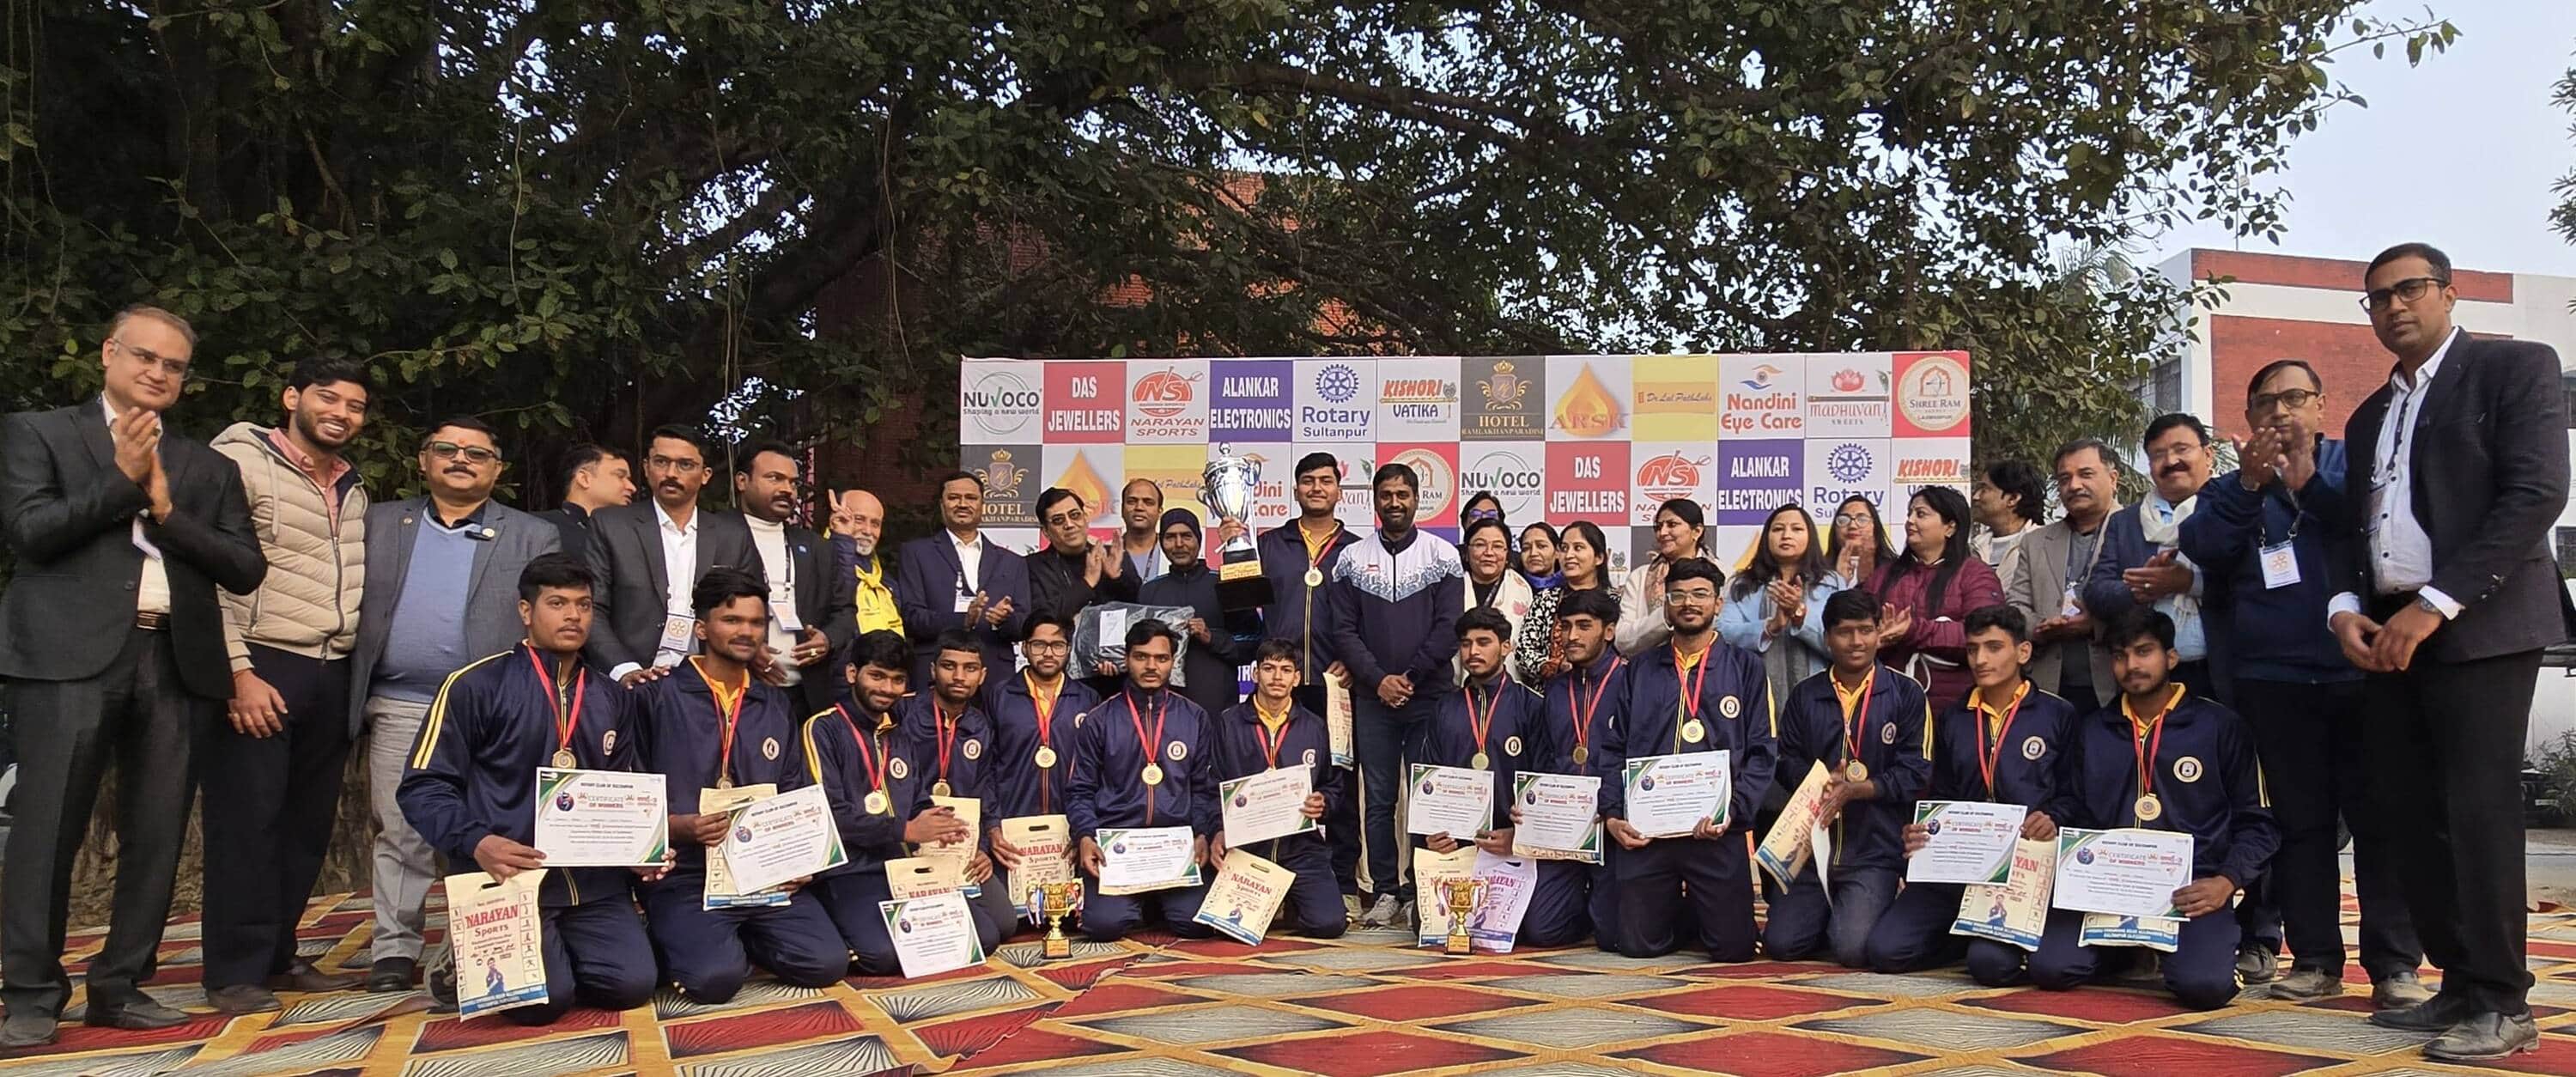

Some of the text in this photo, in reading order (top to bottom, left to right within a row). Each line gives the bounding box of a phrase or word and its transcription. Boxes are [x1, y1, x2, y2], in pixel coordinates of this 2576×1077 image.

[963, 386, 1040, 407] NUVOCO
[1072, 376, 1097, 399] DAS
[1141, 380, 1183, 402] NS
[1223, 377, 1279, 398] ALANKAR
[1383, 379, 1443, 398] KISHORI
[1393, 404, 1439, 417] VATIKA
[1727, 392, 1796, 411] Nandini
[1909, 399, 1960, 408] SHREE RAM
[1048, 410, 1121, 431] JEWELLERS
[1130, 418, 1205, 427] NARAYAN
[1210, 408, 1291, 429] ELECTRONICS
[1302, 406, 1370, 426] Rotary
[1479, 416, 1529, 428] HOTEL
[1721, 412, 1802, 434] Eye Care
[1136, 428, 1199, 436] SPORTS
[1303, 427, 1368, 439] Sultanpur
[1461, 466, 1540, 488] NUVOCO
[1575, 456, 1601, 478] DAS
[1647, 465, 1689, 486] NS
[1731, 456, 1789, 478] ALANKAR
[1898, 459, 1959, 477] KISHORI
[1423, 490, 1443, 499] RAM
[1550, 490, 1625, 513] JEWELLERS
[1718, 489, 1802, 510] ELECTRONICS
[1230, 873, 1273, 894] NARAYAN
[465, 904, 519, 929] NARAYAN
